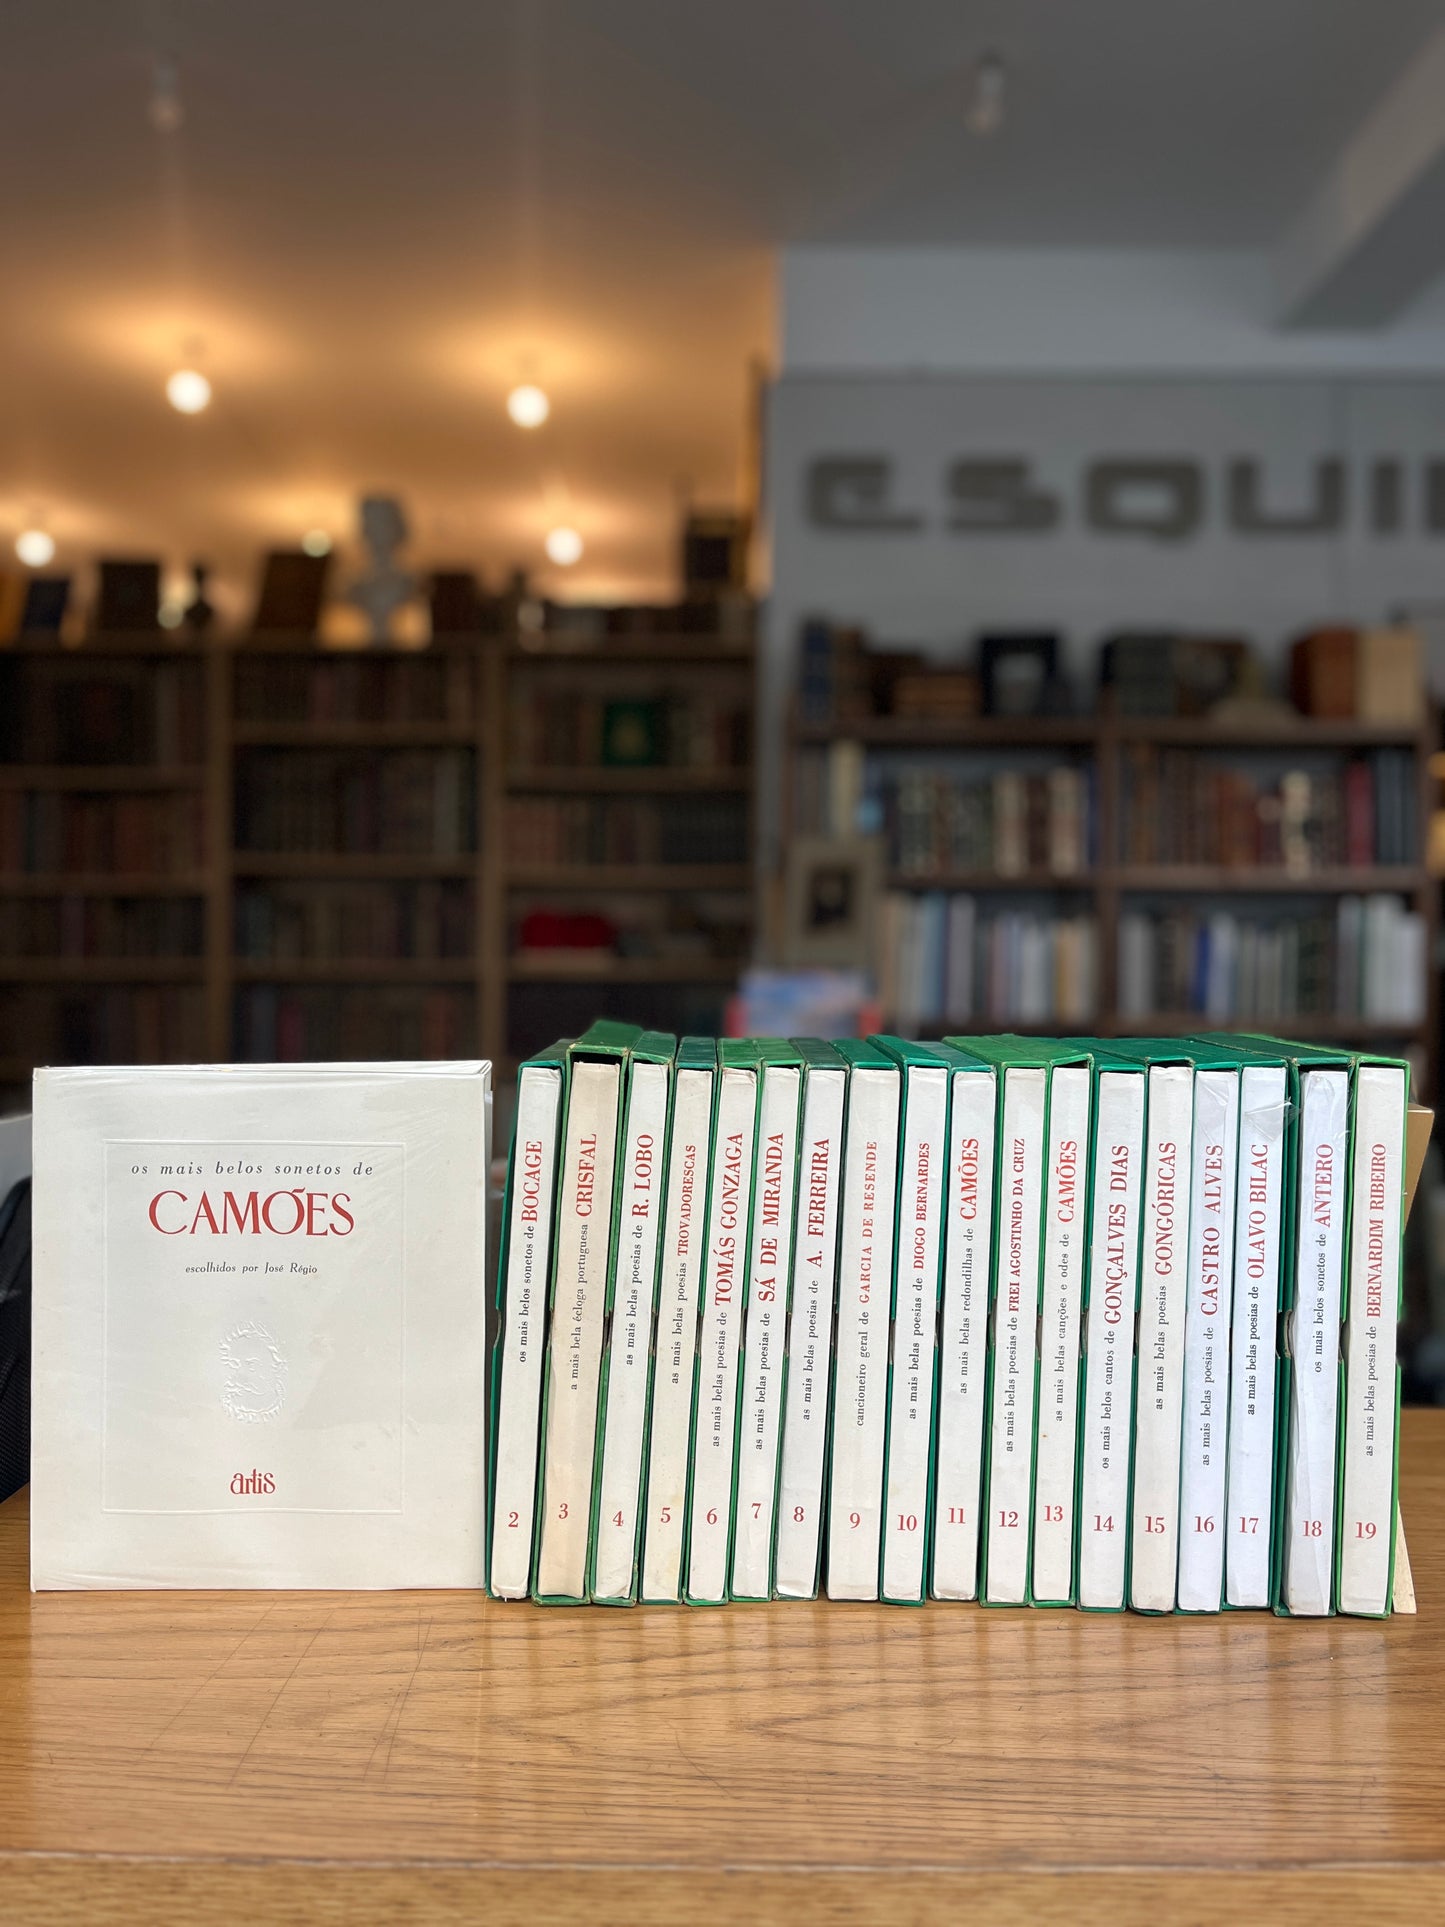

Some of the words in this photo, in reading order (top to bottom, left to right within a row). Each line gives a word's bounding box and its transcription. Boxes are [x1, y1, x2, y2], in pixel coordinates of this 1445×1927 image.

[132, 1165, 149, 1175] os
[160, 1162, 203, 1175] mais
[216, 1161, 263, 1175] belos
[275, 1164, 341, 1176] sonetos
[353, 1162, 373, 1176] de
[633, 1133, 655, 1192] LOBO
[1012, 1137, 1025, 1174] CRUZ
[1109, 1145, 1130, 1193] DIAS
[520, 1140, 543, 1223] BOCAGE
[575, 1133, 597, 1218] CRISFAL
[719, 1132, 744, 1230] GONZAGA
[761, 1132, 784, 1228] MIRANDA
[807, 1138, 830, 1238] FERREIRA
[863, 1141, 878, 1212] RESENDE
[915, 1142, 931, 1222] BERNARDES
[957, 1137, 979, 1221] CAMÕES
[1011, 1177, 1024, 1197] DA
[1055, 1140, 1078, 1223] CAMÕES
[1203, 1144, 1224, 1215] ALVES
[1249, 1144, 1269, 1205] BILAC
[1313, 1143, 1334, 1229] ANTERO
[1369, 1143, 1387, 1211] RIBEIRO
[149, 1187, 355, 1237] CAMÕES
[631, 1198, 650, 1219] R.
[676, 1144, 697, 1257] TROVADORESCAS
[1151, 1141, 1177, 1276] GONGÓRICAS
[523, 1225, 535, 1240] de
[631, 1224, 643, 1239] de
[861, 1218, 874, 1239] DE
[962, 1227, 974, 1242] de
[1009, 1200, 1023, 1278] AGOSTINHO
[1058, 1233, 1070, 1248] de
[1314, 1233, 1327, 1247] de
[577, 1223, 591, 1285] portuguesa
[759, 1237, 779, 1266] DE
[912, 1226, 927, 1270] DIOGO
[1246, 1209, 1267, 1279] OLAVO
[186, 1262, 237, 1274] escolhidos
[242, 1266, 259, 1275] por
[265, 1262, 285, 1275] José
[290, 1262, 318, 1276] Régio
[523, 1243, 534, 1285] sonetos
[629, 1243, 643, 1285] poesias
[712, 1236, 736, 1307] TOMÁS
[805, 1249, 823, 1269] A.
[1057, 1253, 1069, 1279] odes
[1103, 1203, 1129, 1325] GONÇALVES
[1200, 1226, 1221, 1317] CASTRO
[1315, 1252, 1326, 1292] sonetos
[1366, 1218, 1384, 1319] BERNARDIM
[675, 1262, 689, 1302] poesias
[807, 1279, 819, 1295] de
[858, 1245, 873, 1304] GARCIA
[911, 1277, 924, 1292] de
[960, 1247, 973, 1312] redondilhas
[1059, 1283, 1068, 1291] e
[517, 1287, 531, 1317] belos
[625, 1288, 639, 1318] belas
[753, 1276, 777, 1303] SÁ
[1008, 1281, 1021, 1313] FREI
[1247, 1285, 1259, 1300] de
[571, 1287, 587, 1323] écloga
[715, 1311, 728, 1326] de
[857, 1311, 870, 1326] de
[911, 1297, 925, 1337] poesias
[1057, 1297, 1069, 1339] canções
[1155, 1285, 1170, 1326] poesias
[1312, 1297, 1325, 1325] belos
[671, 1307, 684, 1335] belas
[759, 1312, 771, 1327] de
[806, 1299, 819, 1339] poesias
[958, 1317, 971, 1345] belas
[1006, 1316, 1018, 1331] de
[1247, 1303, 1261, 1341] poesias
[1365, 1325, 1377, 1340] de
[517, 1320, 529, 1347] mais
[569, 1326, 582, 1350] bela
[624, 1322, 637, 1349] mais
[857, 1331, 871, 1359] geral
[1103, 1330, 1115, 1345] de
[1153, 1331, 1166, 1361] belas
[1202, 1327, 1214, 1341] de
[1311, 1329, 1324, 1355] mais
[519, 1350, 527, 1363] os
[625, 1353, 634, 1366] as
[670, 1341, 682, 1367] mais
[714, 1329, 728, 1369] poesias
[758, 1331, 772, 1371] poesias
[802, 1344, 815, 1373] belas
[907, 1342, 921, 1371] belas
[1005, 1335, 1020, 1375] poesias
[1053, 1345, 1066, 1373] belas
[1245, 1343, 1257, 1371] belas
[1364, 1343, 1379, 1382] poesias
[567, 1353, 580, 1379] mais
[957, 1351, 969, 1377] mais
[1103, 1349, 1115, 1386] cantos
[1201, 1345, 1216, 1384] poesias
[1314, 1361, 1323, 1373] os
[570, 1383, 578, 1391] a
[671, 1372, 680, 1385] as
[711, 1373, 724, 1402] belas
[754, 1375, 767, 1403] belas
[801, 1377, 813, 1403] mais
[907, 1376, 919, 1403] mais
[959, 1382, 968, 1395] as
[1053, 1378, 1065, 1404] mais
[1153, 1365, 1165, 1393] mais
[1245, 1374, 1257, 1400] mais
[854, 1363, 867, 1427] cancioneiro
[1003, 1378, 1016, 1407] belas
[1099, 1391, 1113, 1420] belos
[1155, 1397, 1164, 1411] as
[1199, 1389, 1212, 1417] belas
[1363, 1385, 1376, 1413] belas
[711, 1405, 722, 1432] mais
[753, 1408, 765, 1434] mais
[802, 1408, 811, 1421] as
[909, 1407, 917, 1420] as
[1055, 1409, 1063, 1422] as
[1247, 1403, 1256, 1416] as
[1003, 1410, 1015, 1437] mais
[1199, 1422, 1211, 1449] mais
[1363, 1415, 1375, 1441] mais
[712, 1435, 721, 1447] as
[755, 1438, 764, 1451] as
[1005, 1440, 1014, 1453] as
[1099, 1425, 1111, 1451] mais
[1365, 1445, 1374, 1457] as
[1101, 1457, 1110, 1470] os
[1202, 1453, 1210, 1467] as
[230, 1468, 277, 1495] artis
[508, 1512, 519, 1529] 2
[558, 1503, 569, 1520] 3
[612, 1511, 625, 1527] 4
[660, 1507, 671, 1524] 5
[706, 1508, 719, 1526] 6
[751, 1503, 763, 1520] 7
[794, 1506, 805, 1523] 8
[850, 1512, 861, 1530] 9
[897, 1515, 918, 1532] 10
[948, 1508, 966, 1525] 11
[999, 1511, 1019, 1528] 12
[1044, 1506, 1064, 1523] 13
[1094, 1515, 1115, 1533] 14
[1194, 1516, 1215, 1534] 16
[1145, 1516, 1166, 1535] 15
[1240, 1517, 1260, 1535] 17
[1303, 1520, 1323, 1538] 18
[1356, 1522, 1377, 1540] 19
